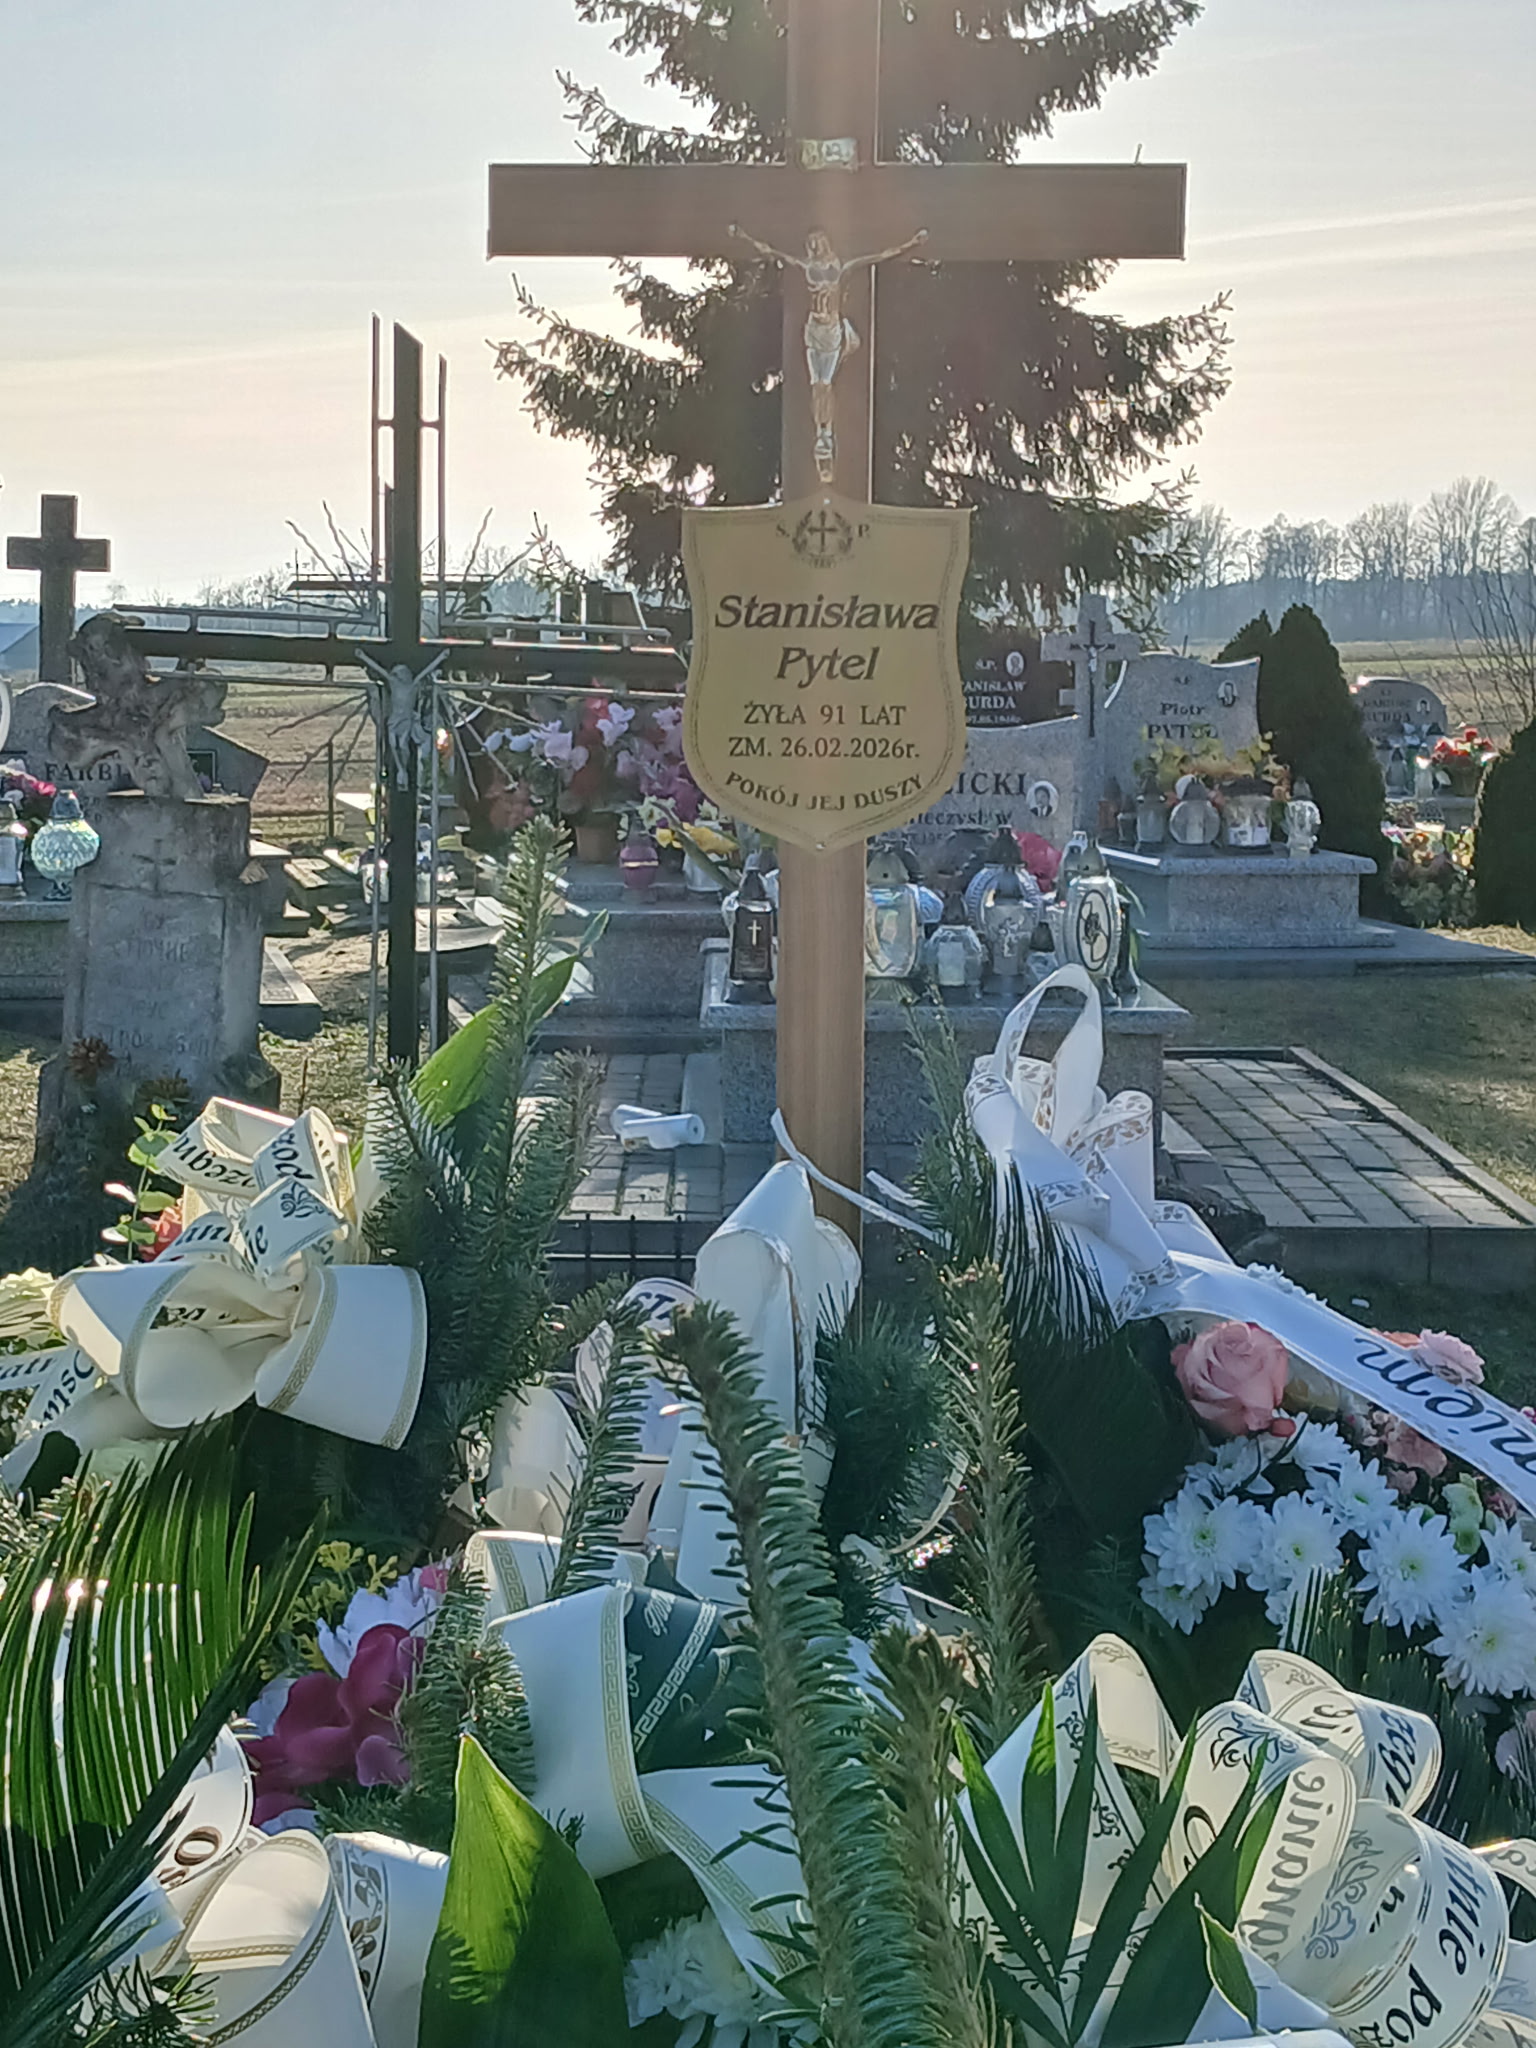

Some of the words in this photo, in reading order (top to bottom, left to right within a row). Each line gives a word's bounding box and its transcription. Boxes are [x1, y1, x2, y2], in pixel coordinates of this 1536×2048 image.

[715, 594, 940, 629] Stanisława
[776, 646, 880, 689] Pytel
[744, 700, 806, 725] ŻYŁA
[820, 704, 845, 725] 91
[861, 704, 907, 726] LAT
[965, 695, 1017, 710] URDA
[1161, 702, 1206, 716] Piotr
[728, 736, 772, 758] ZM.
[781, 736, 920, 759] 26.02.2026r.
[725, 771, 799, 808] POKÓJ
[806, 794, 846, 811] JEJ
[854, 773, 922, 809] DUSZY
[946, 772, 1027, 796] ICKI
